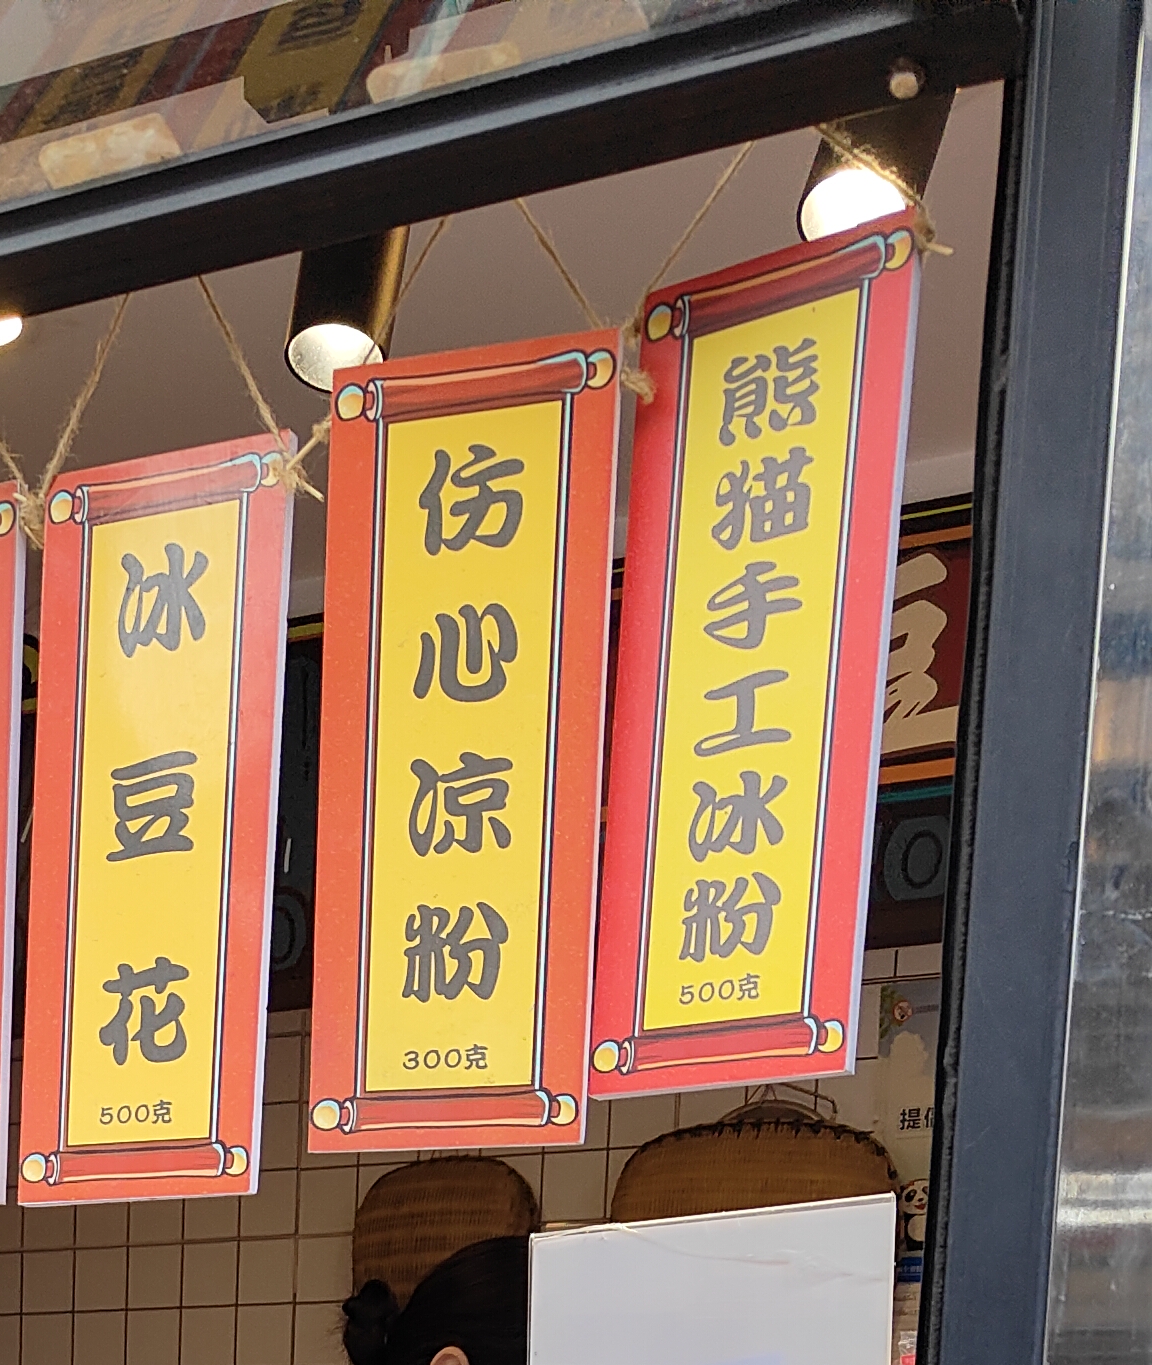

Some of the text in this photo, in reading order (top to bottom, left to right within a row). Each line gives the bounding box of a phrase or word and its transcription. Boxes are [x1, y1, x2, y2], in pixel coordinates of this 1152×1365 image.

[401, 444, 525, 1003] 伤心凉粉
[677, 337, 821, 963] 熊猫手工冰粉
[98, 543, 209, 1066] 冰豆花
[99, 1099, 172, 1125] 500克
[402, 1044, 488, 1070] 300克
[679, 973, 760, 1005] 500克
